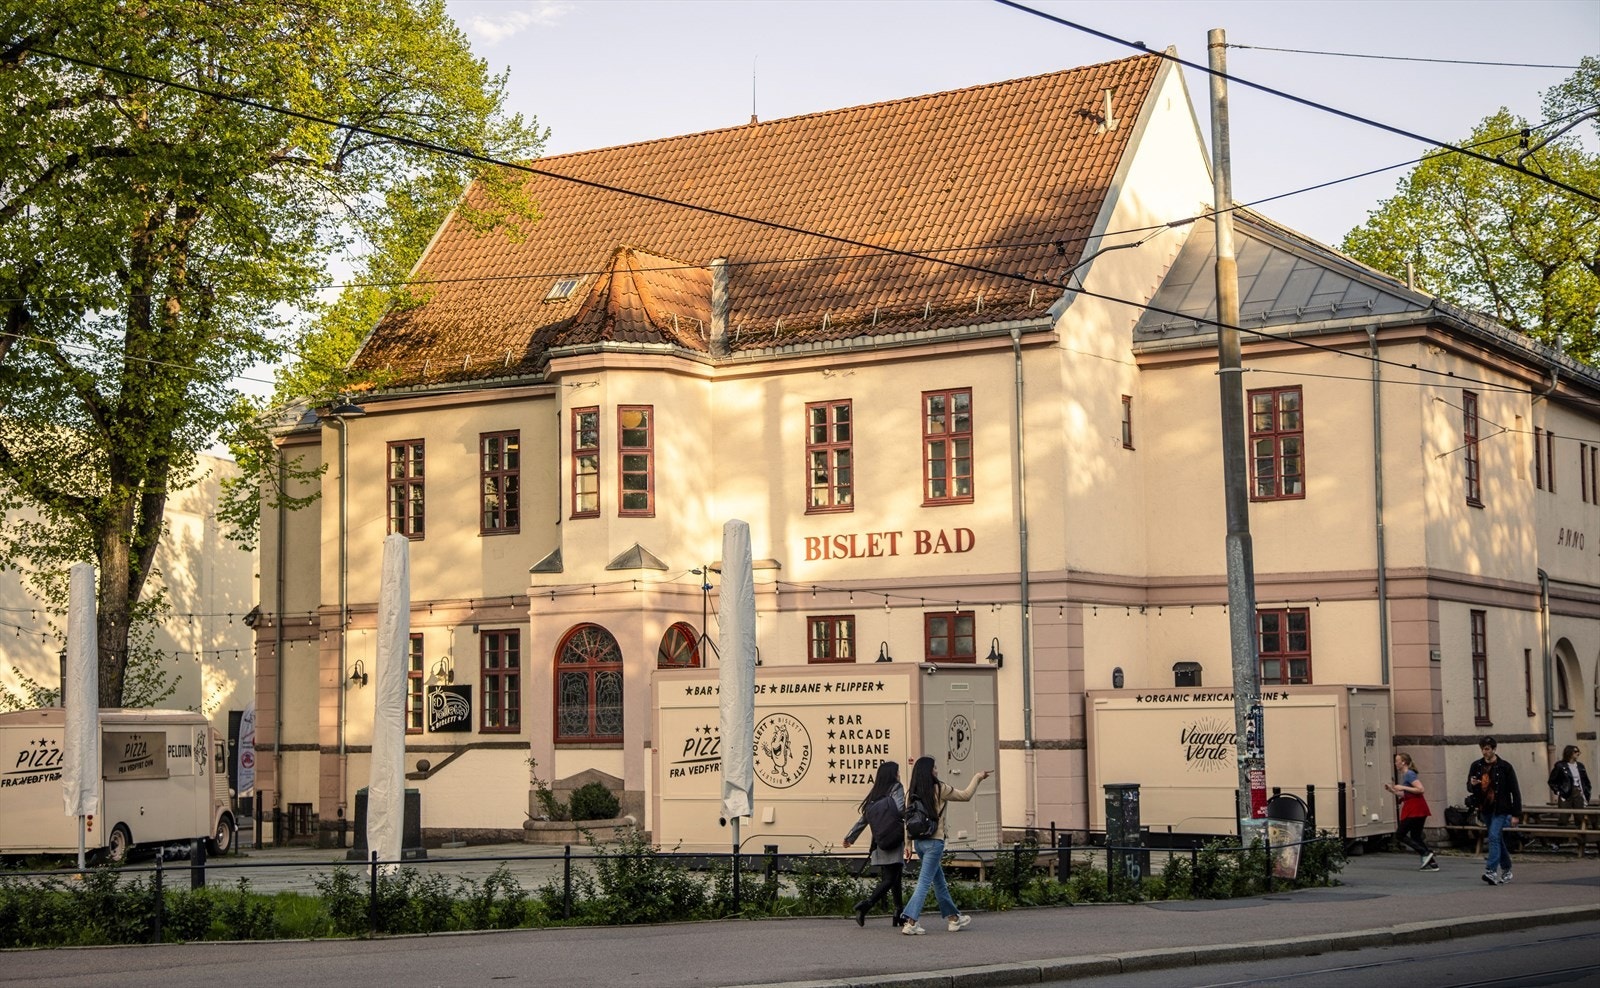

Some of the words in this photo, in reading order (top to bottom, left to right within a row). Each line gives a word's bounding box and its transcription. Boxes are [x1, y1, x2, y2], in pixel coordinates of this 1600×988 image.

[804, 530, 903, 561] BISLET
[913, 527, 976, 555] BAD
[1557, 527, 1585, 551] ANNO
[694, 686, 713, 696] BAR
[780, 683, 821, 693] BILBANE
[835, 681, 874, 692] FLIPPER
[1144, 693, 1190, 703] ORGANIC
[778, 717, 802, 733] BISLETT
[838, 714, 863, 725] BAR
[839, 729, 890, 740] ARCADE
[1180, 725, 1237, 748] Vaquera
[124, 742, 147, 758] PIZZA
[167, 744, 192, 758] PELOTON
[683, 735, 721, 757] PIZZ
[839, 744, 889, 755] BILBANE
[1186, 744, 1227, 761] Verde
[793, 744, 809, 780] POLLETT
[669, 767, 686, 778] FRA
[688, 762, 722, 776] VEDFYR
[1, 778, 18, 788] FRA
[839, 774, 875, 784] PIZZA
